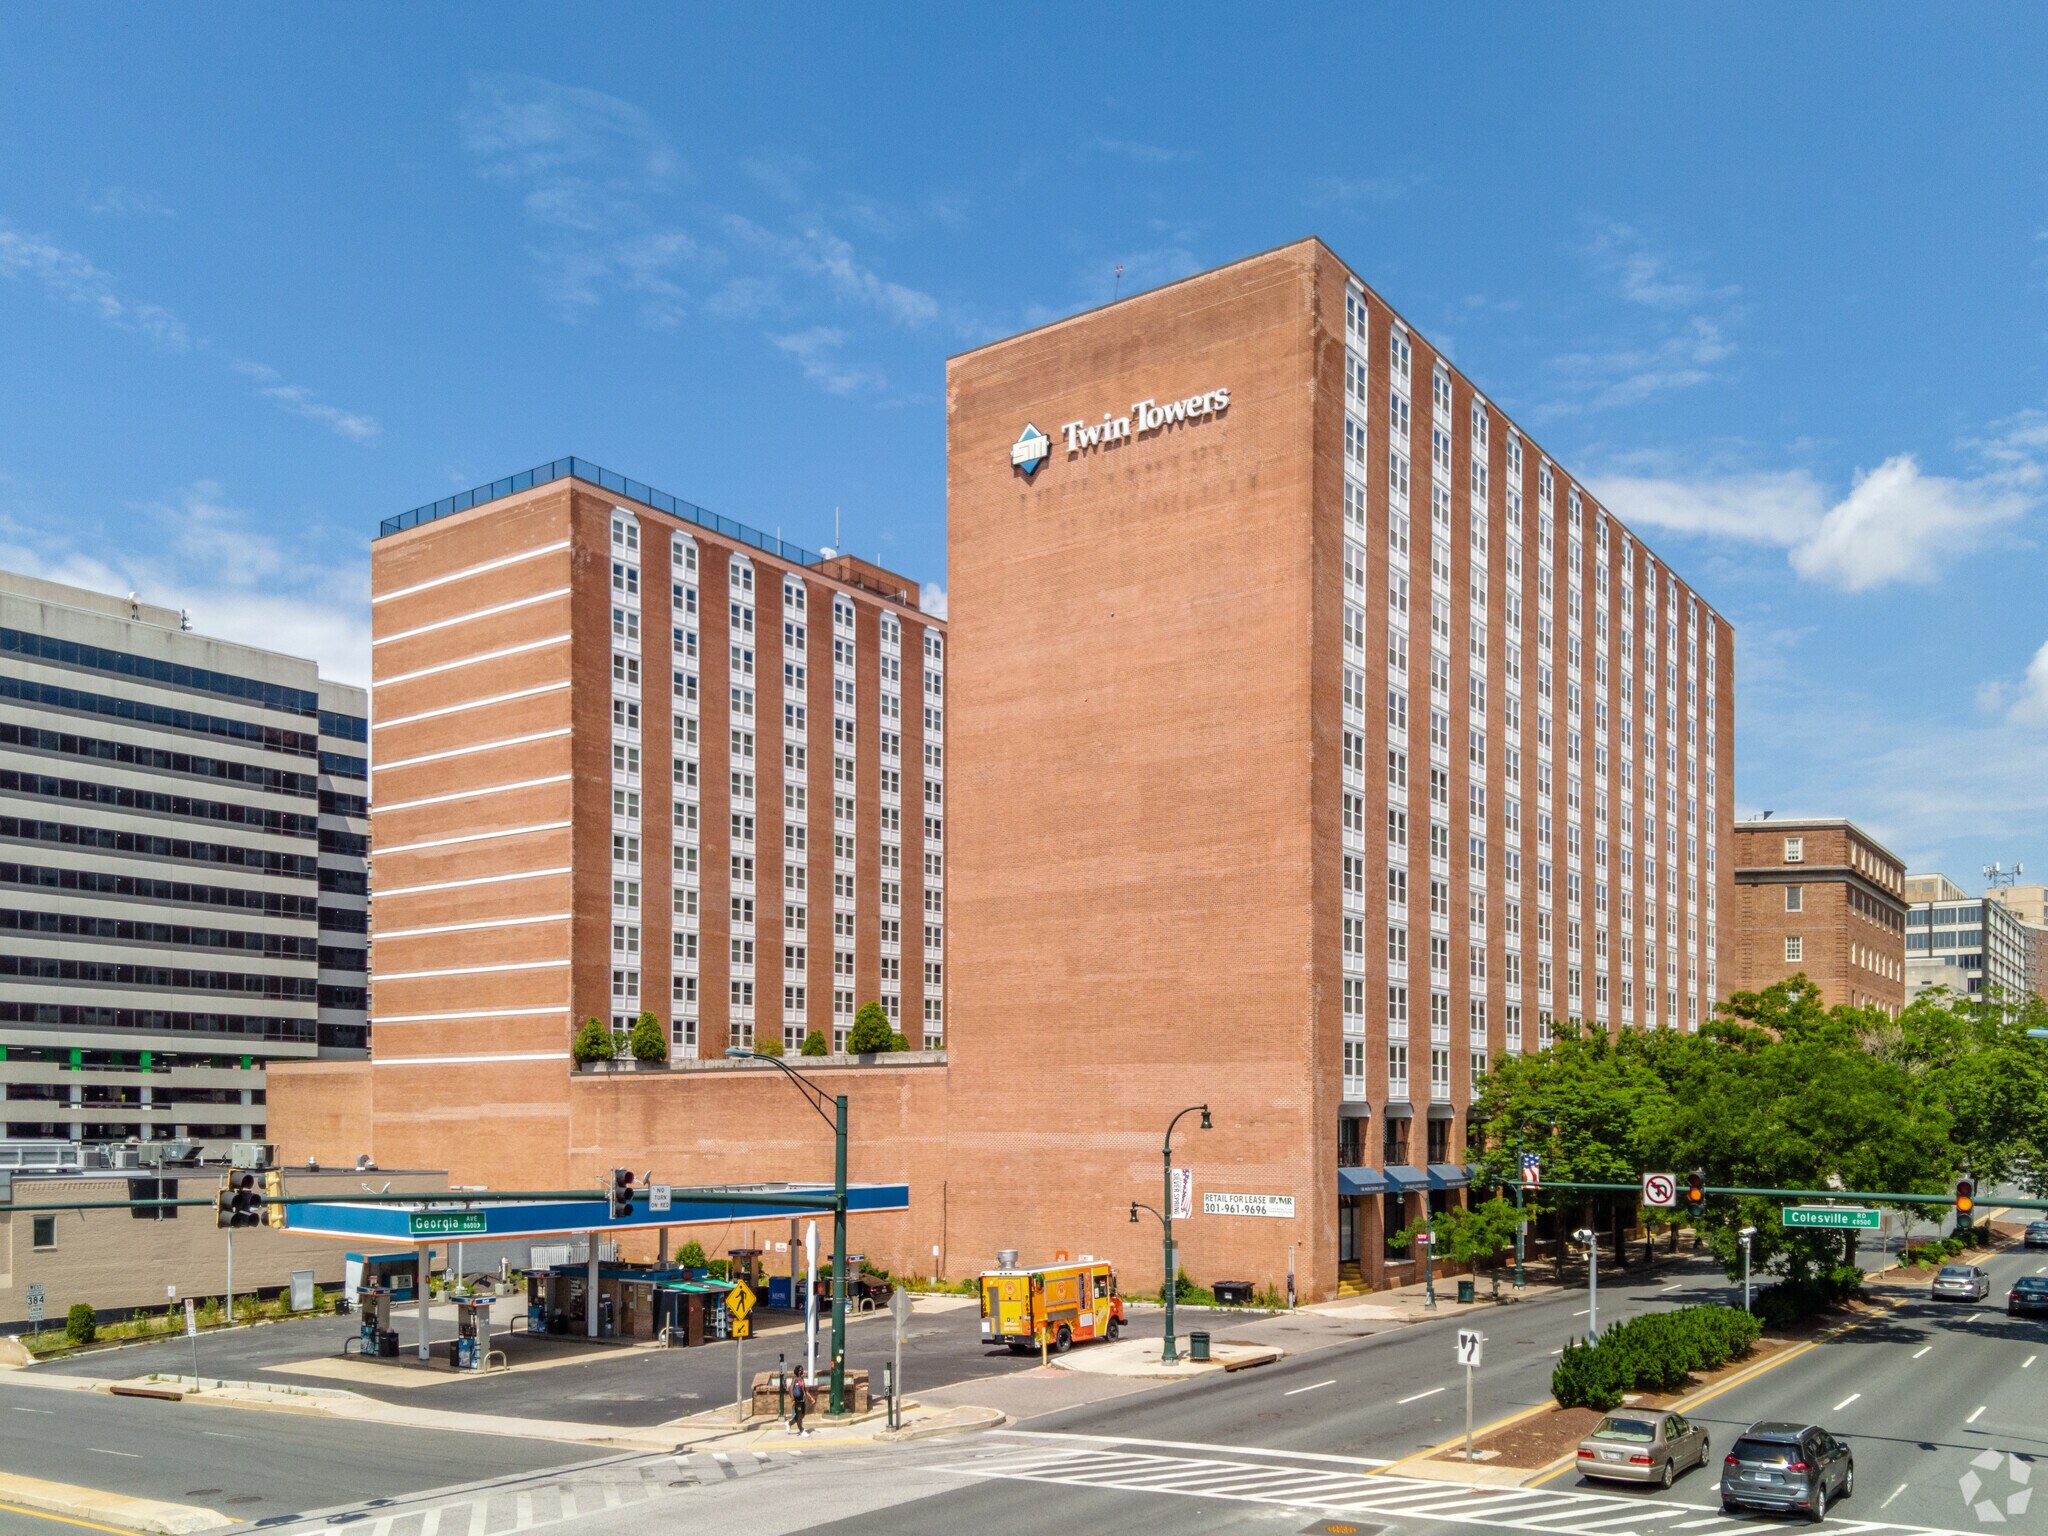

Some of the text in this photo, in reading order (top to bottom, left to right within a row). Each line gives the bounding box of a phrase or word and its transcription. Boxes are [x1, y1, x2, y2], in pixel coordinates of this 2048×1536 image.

[1062, 387, 1231, 452] Twin Towers
[1205, 1194, 1267, 1204] RETAIL FOR LEASE
[1205, 1203, 1267, 1215] 301-961-9696
[1792, 1212, 1848, 1224] Colesville
[415, 1217, 459, 1232] Georgia
[27, 1295, 44, 1305] 384
